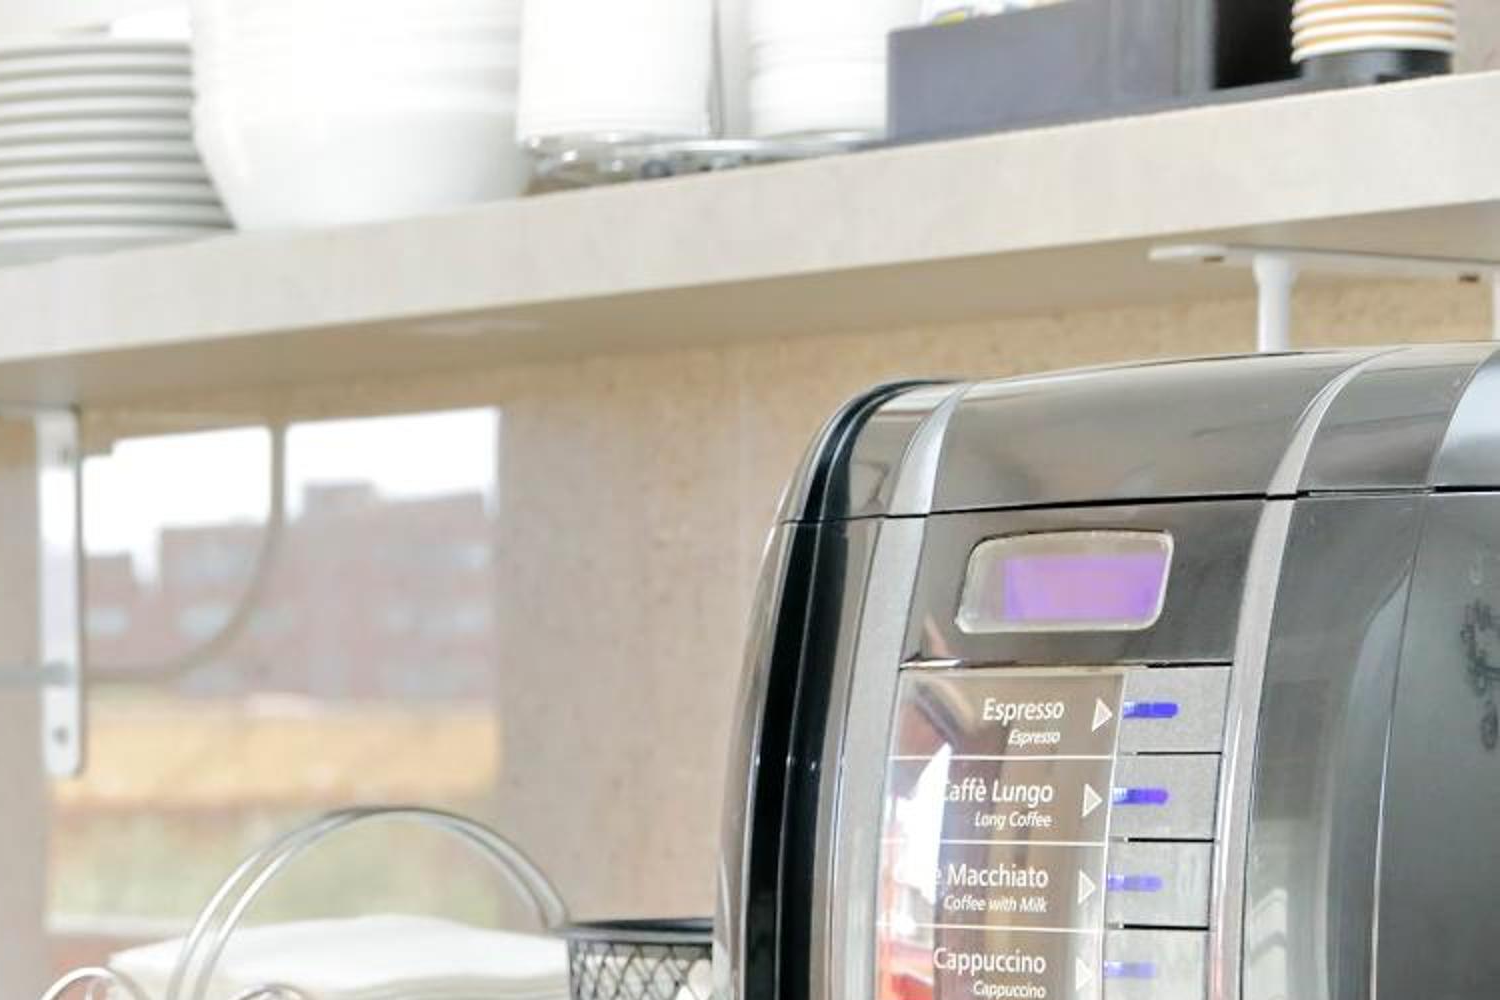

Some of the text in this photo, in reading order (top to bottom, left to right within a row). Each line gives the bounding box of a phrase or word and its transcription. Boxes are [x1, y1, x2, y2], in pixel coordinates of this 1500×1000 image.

[983, 698, 1065, 725] Espresso
[1008, 728, 1061, 748] Espresso
[991, 779, 1054, 808] Lungo
[975, 811, 1053, 831] Long Coffee
[947, 863, 1049, 888] Macchiato
[943, 895, 1048, 913] Coffee with Milk
[933, 947, 1046, 975] Cappuccino
[973, 980, 1046, 1000] Cappuccino
